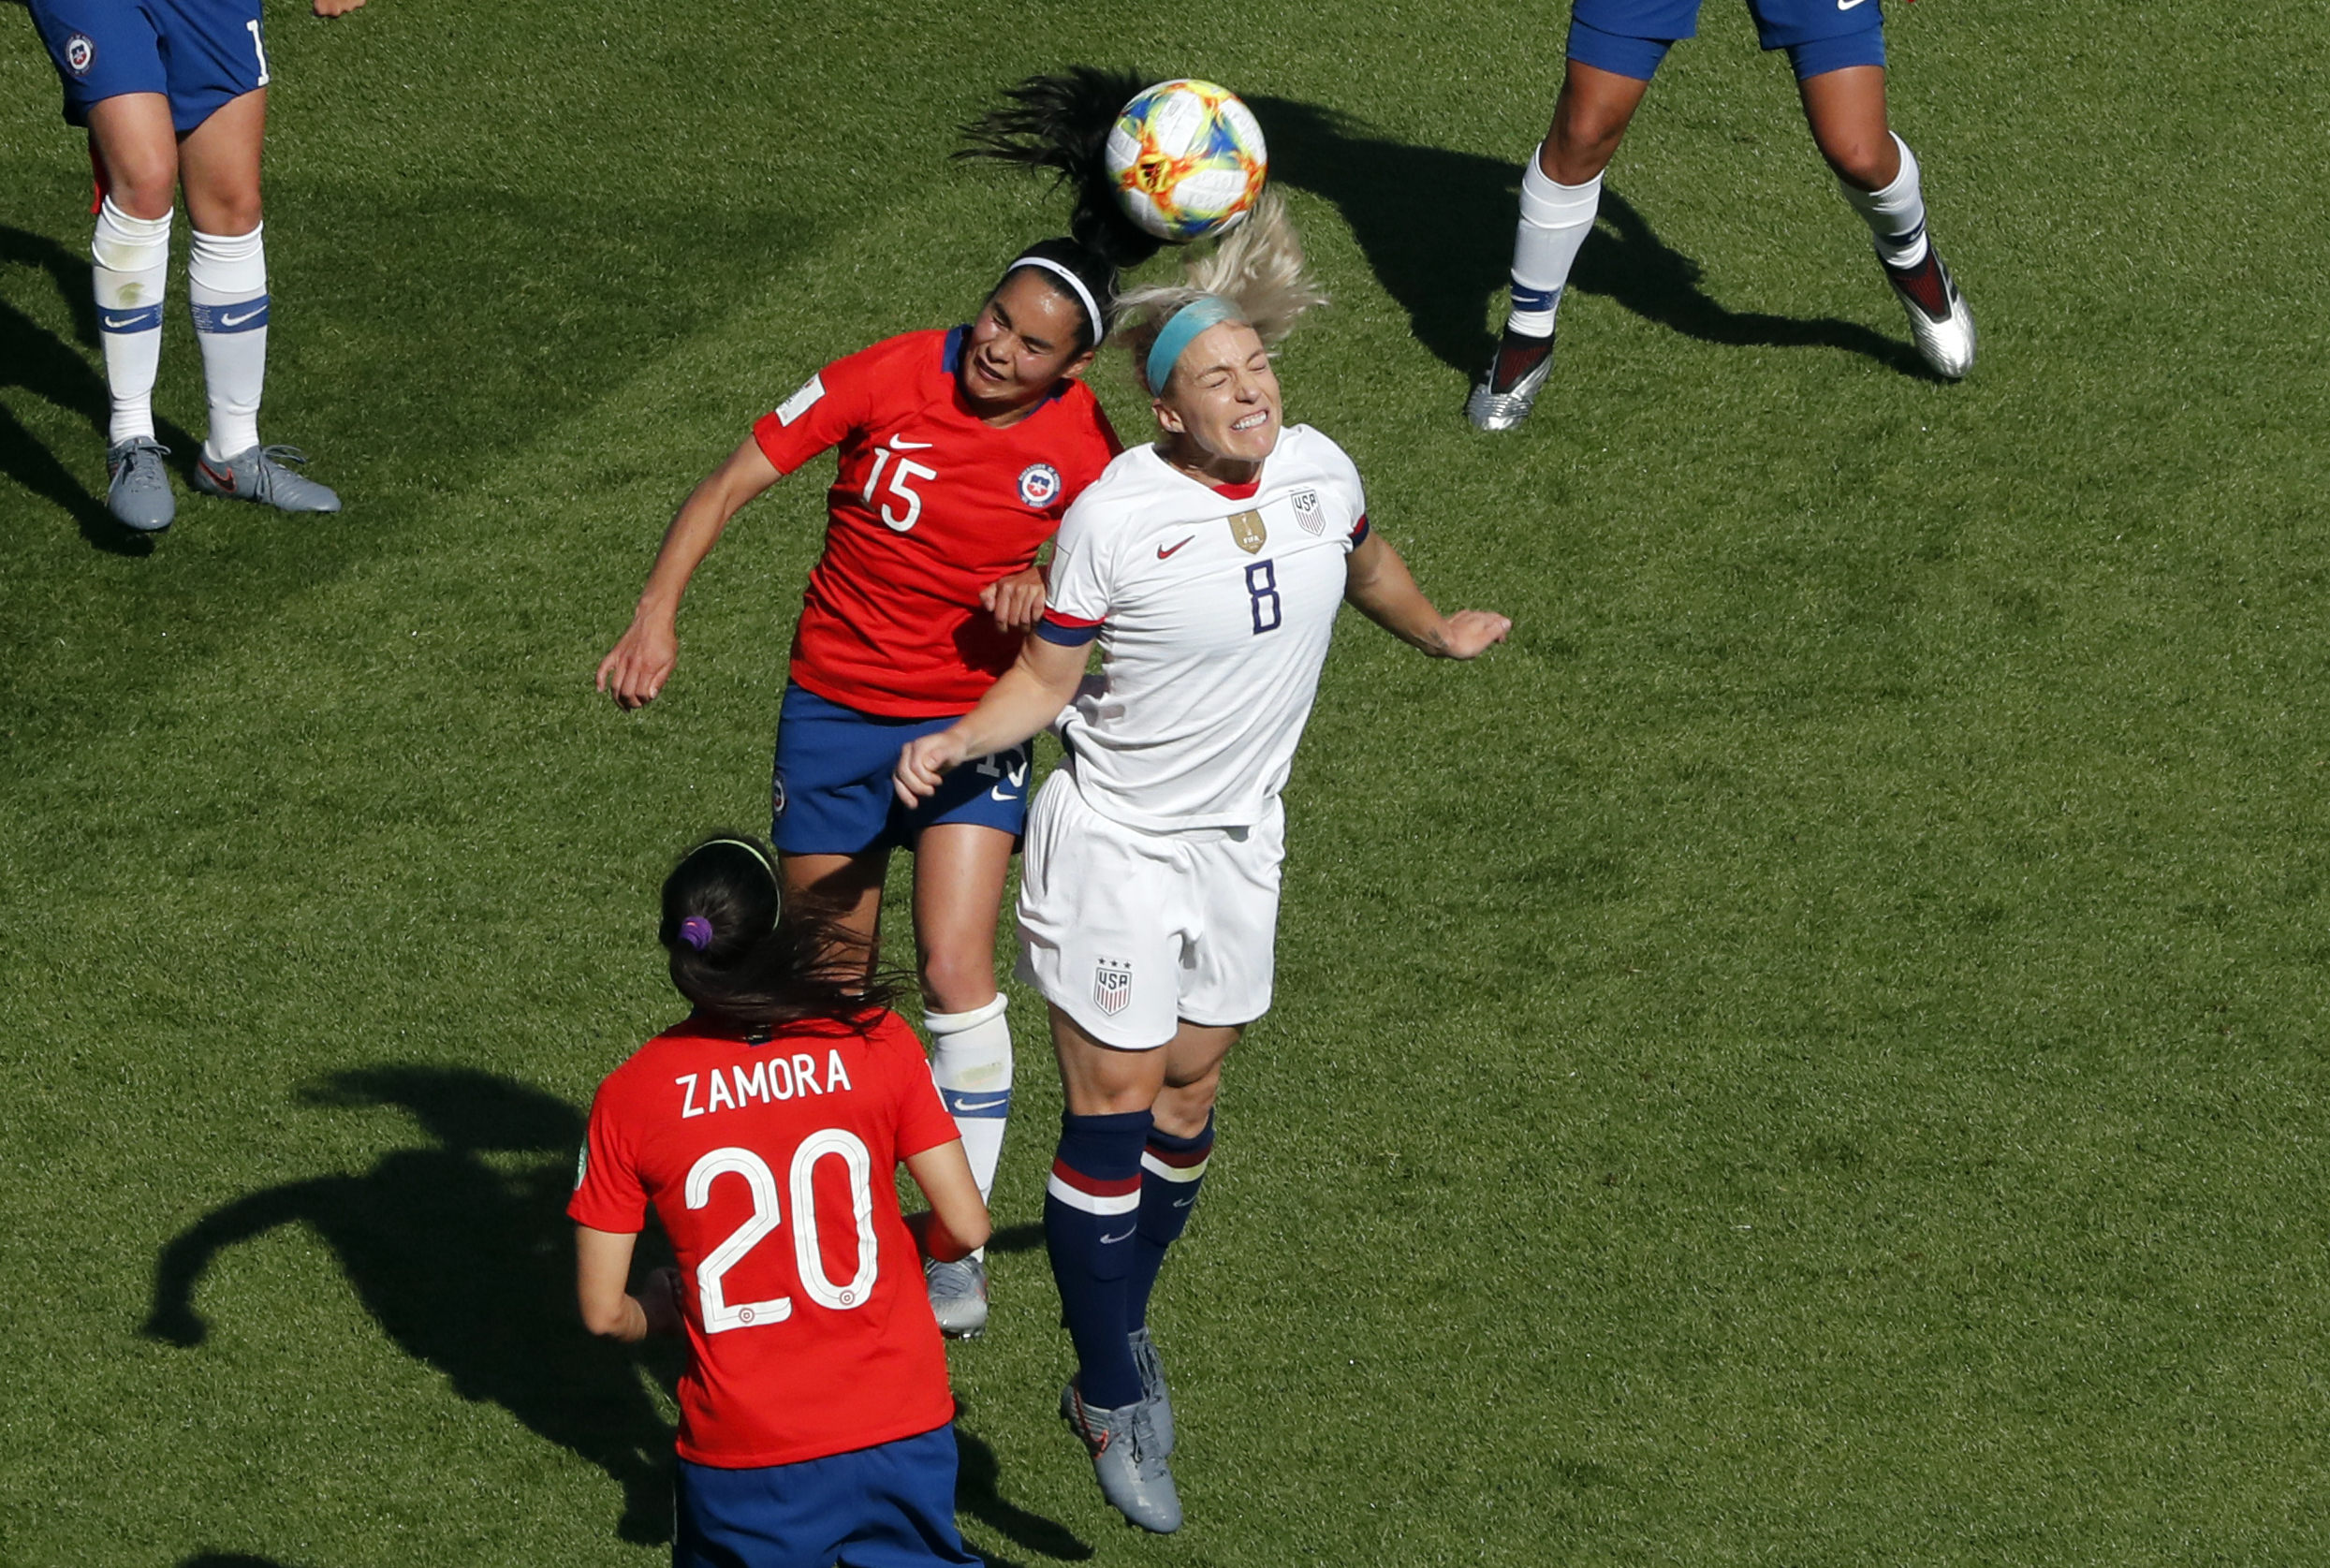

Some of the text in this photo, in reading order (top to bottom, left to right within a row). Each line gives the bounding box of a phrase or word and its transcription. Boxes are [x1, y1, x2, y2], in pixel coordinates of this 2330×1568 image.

[861, 447, 938, 533] 15
[1294, 493, 1317, 512] USA
[1243, 558, 1282, 635] 8
[1098, 971, 1129, 990] USA
[675, 1048, 852, 1119] ZAMORA
[684, 1128, 878, 1334] 20
